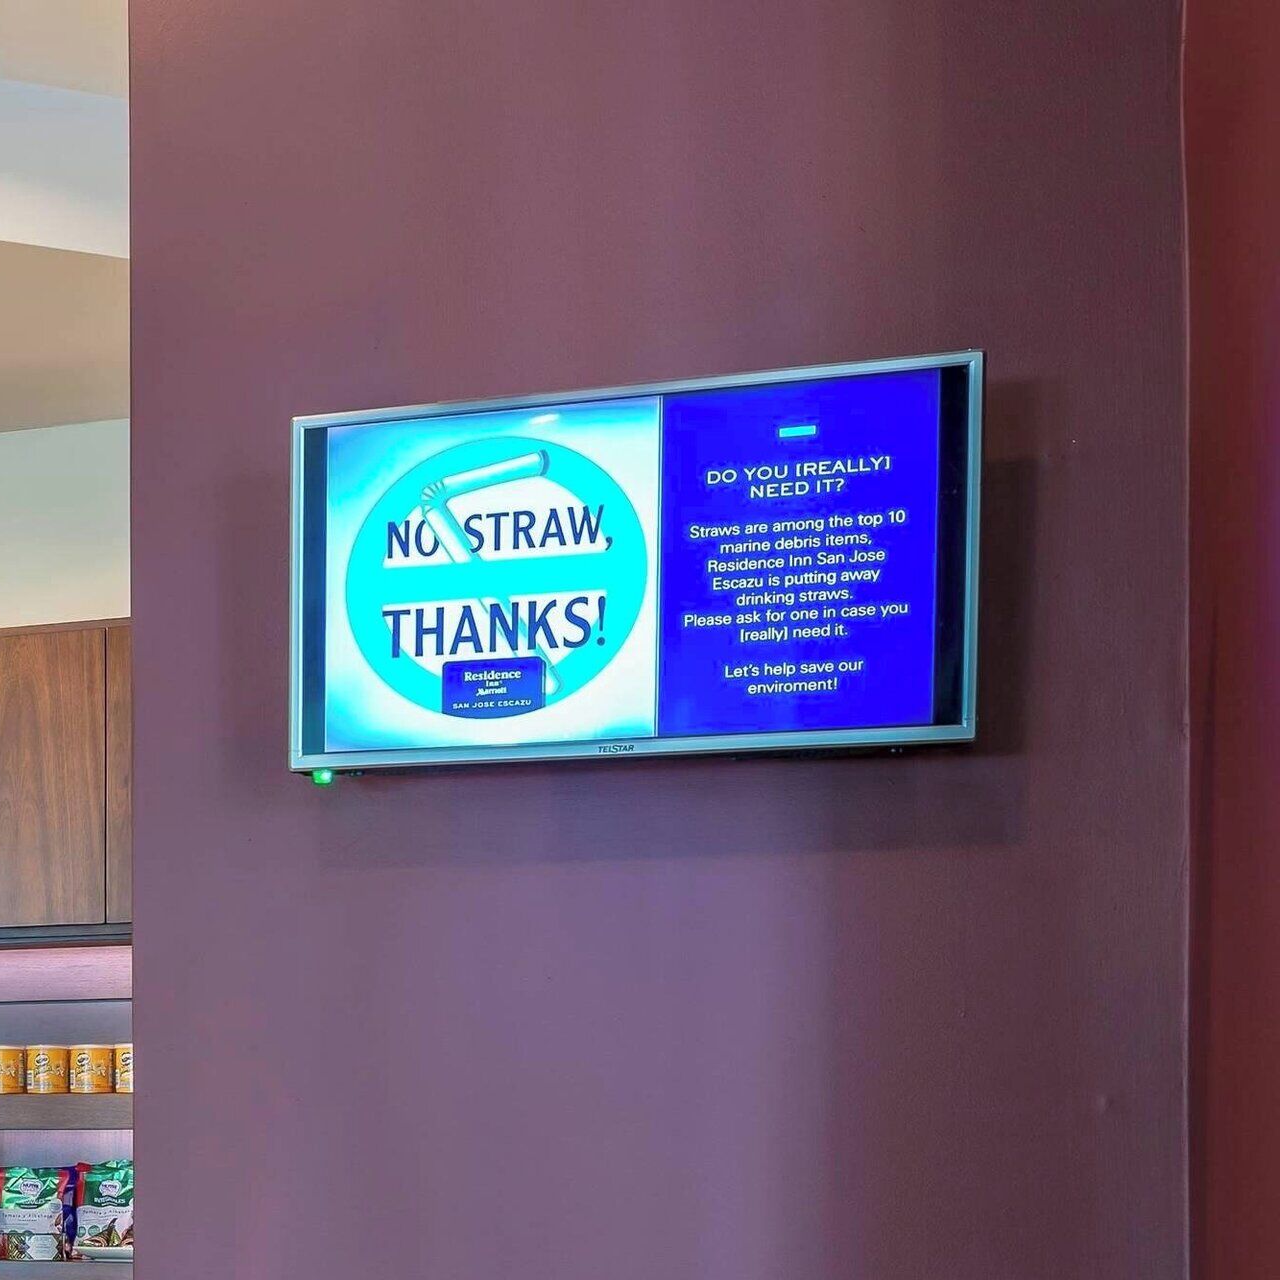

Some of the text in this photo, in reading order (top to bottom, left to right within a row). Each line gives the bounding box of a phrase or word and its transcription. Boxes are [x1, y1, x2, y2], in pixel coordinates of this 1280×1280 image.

[707, 456, 891, 484] DO YOU [REALLY]
[750, 479, 845, 499] NEED IT?
[387, 504, 614, 557] NO STRAW,
[690, 510, 906, 538] Straws are among the top 10
[720, 532, 872, 554] marine debris items,
[708, 550, 886, 571] Residence Inn San Jose
[712, 569, 881, 591] Escazu is putting away
[736, 589, 854, 607] drinking straws.
[684, 604, 909, 627] Please ask for one in case you
[382, 596, 607, 659] THANKS!
[740, 623, 849, 643] [really] need it.
[464, 670, 522, 682] Residence
[724, 659, 863, 678] Let's help save our
[747, 677, 838, 695] enviroment!
[497, 699, 532, 707] ESCAZU
